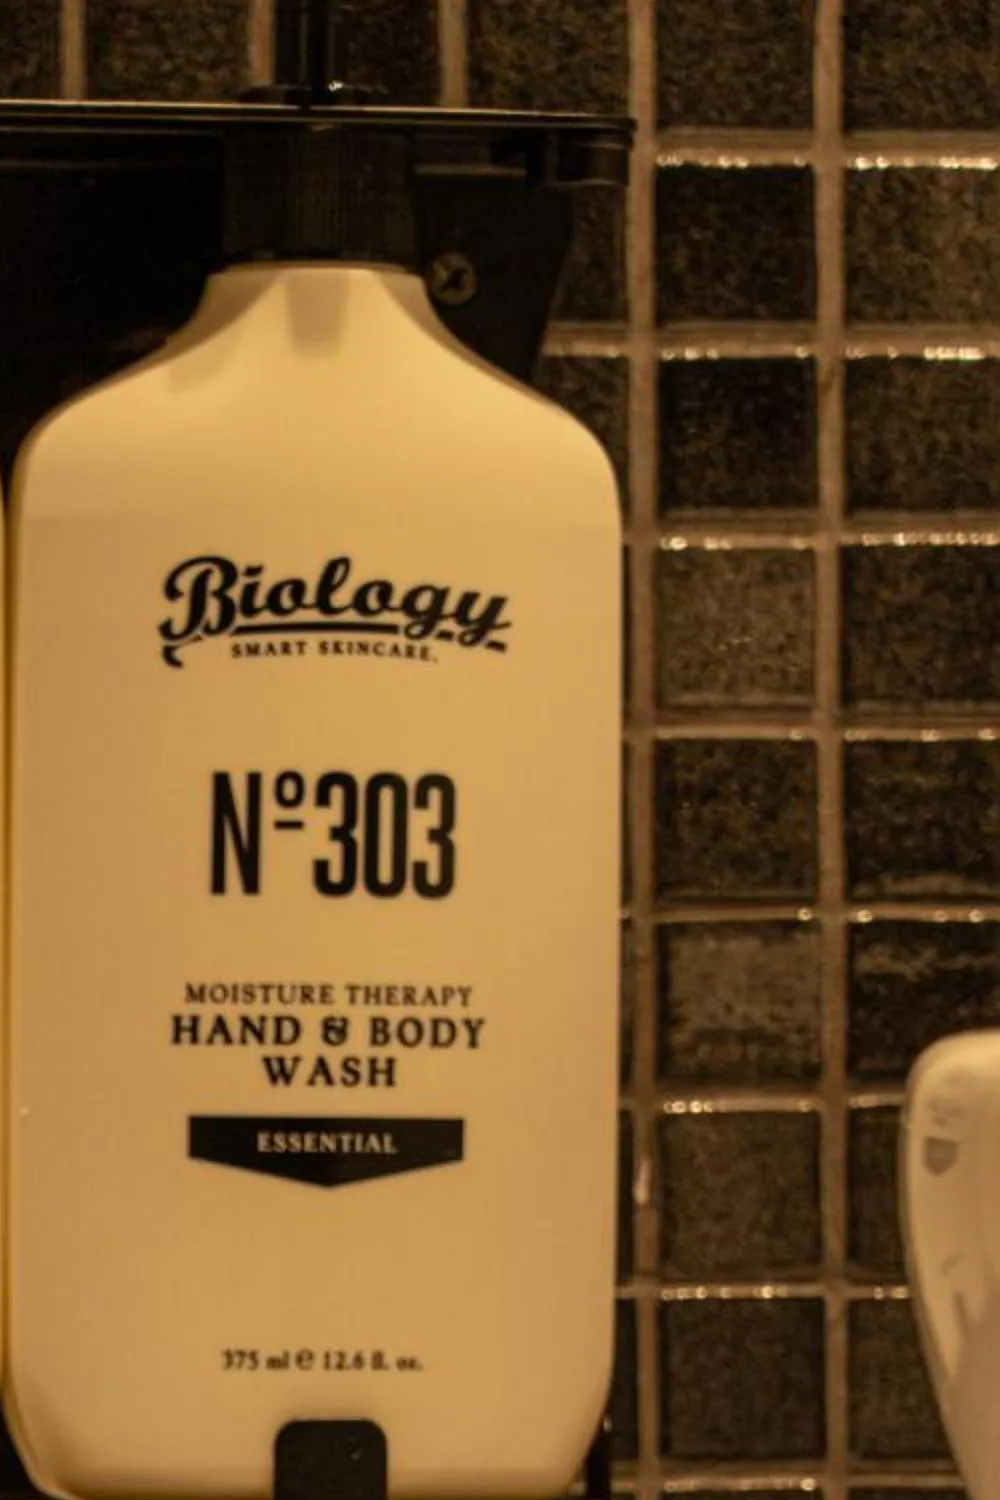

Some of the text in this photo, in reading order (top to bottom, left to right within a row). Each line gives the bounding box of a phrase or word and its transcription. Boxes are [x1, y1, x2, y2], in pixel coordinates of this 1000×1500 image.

[158, 556, 512, 668] Biology
[231, 640, 308, 658] SMART
[185, 983, 472, 1008] MOISTURE THERAPY
[171, 1014, 485, 1049] HAND & BODY
[262, 1056, 398, 1087] WASH
[257, 1132, 398, 1154] ESSENTIAL
[222, 1349, 259, 1371] 375
[266, 1350, 290, 1370] ml
[323, 1350, 365, 1371] 12.6
